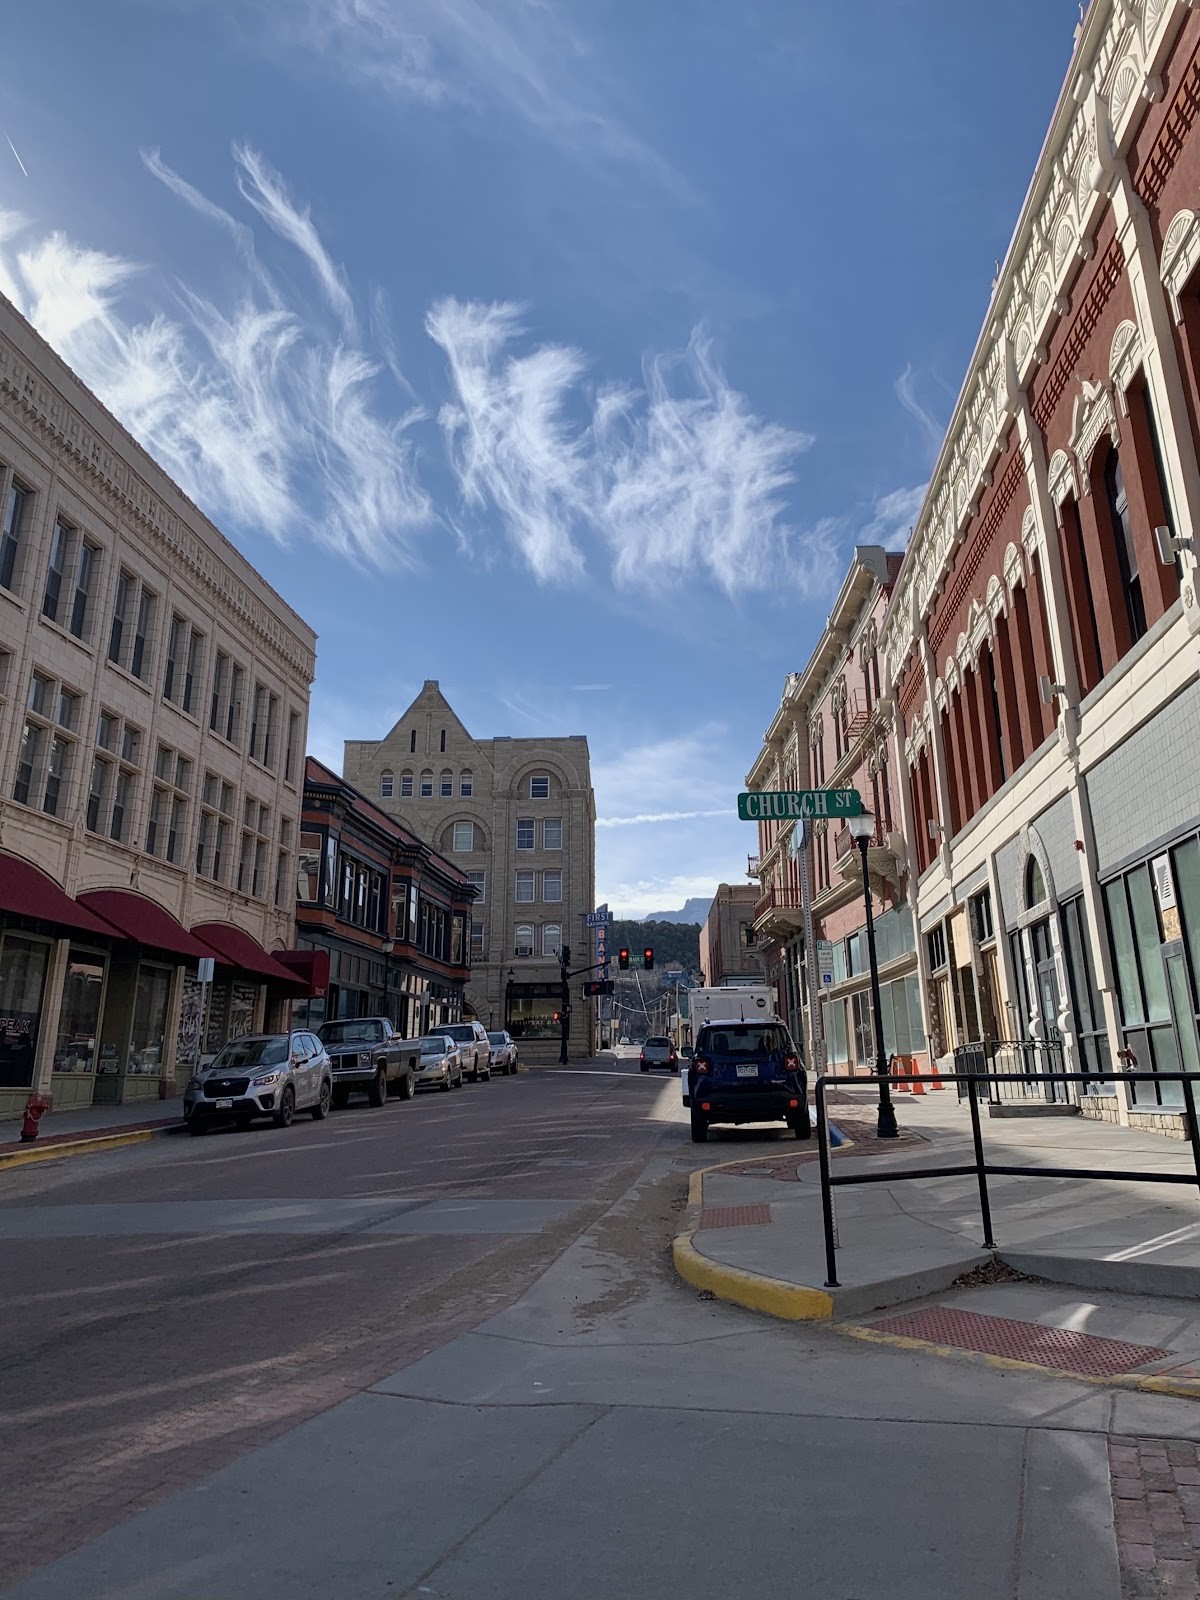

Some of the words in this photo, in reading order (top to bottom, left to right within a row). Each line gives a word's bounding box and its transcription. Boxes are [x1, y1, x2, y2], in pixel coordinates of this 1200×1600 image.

[746, 793, 828, 817] CHURCH
[835, 792, 852, 807] ST
[587, 913, 609, 922] FIRST
